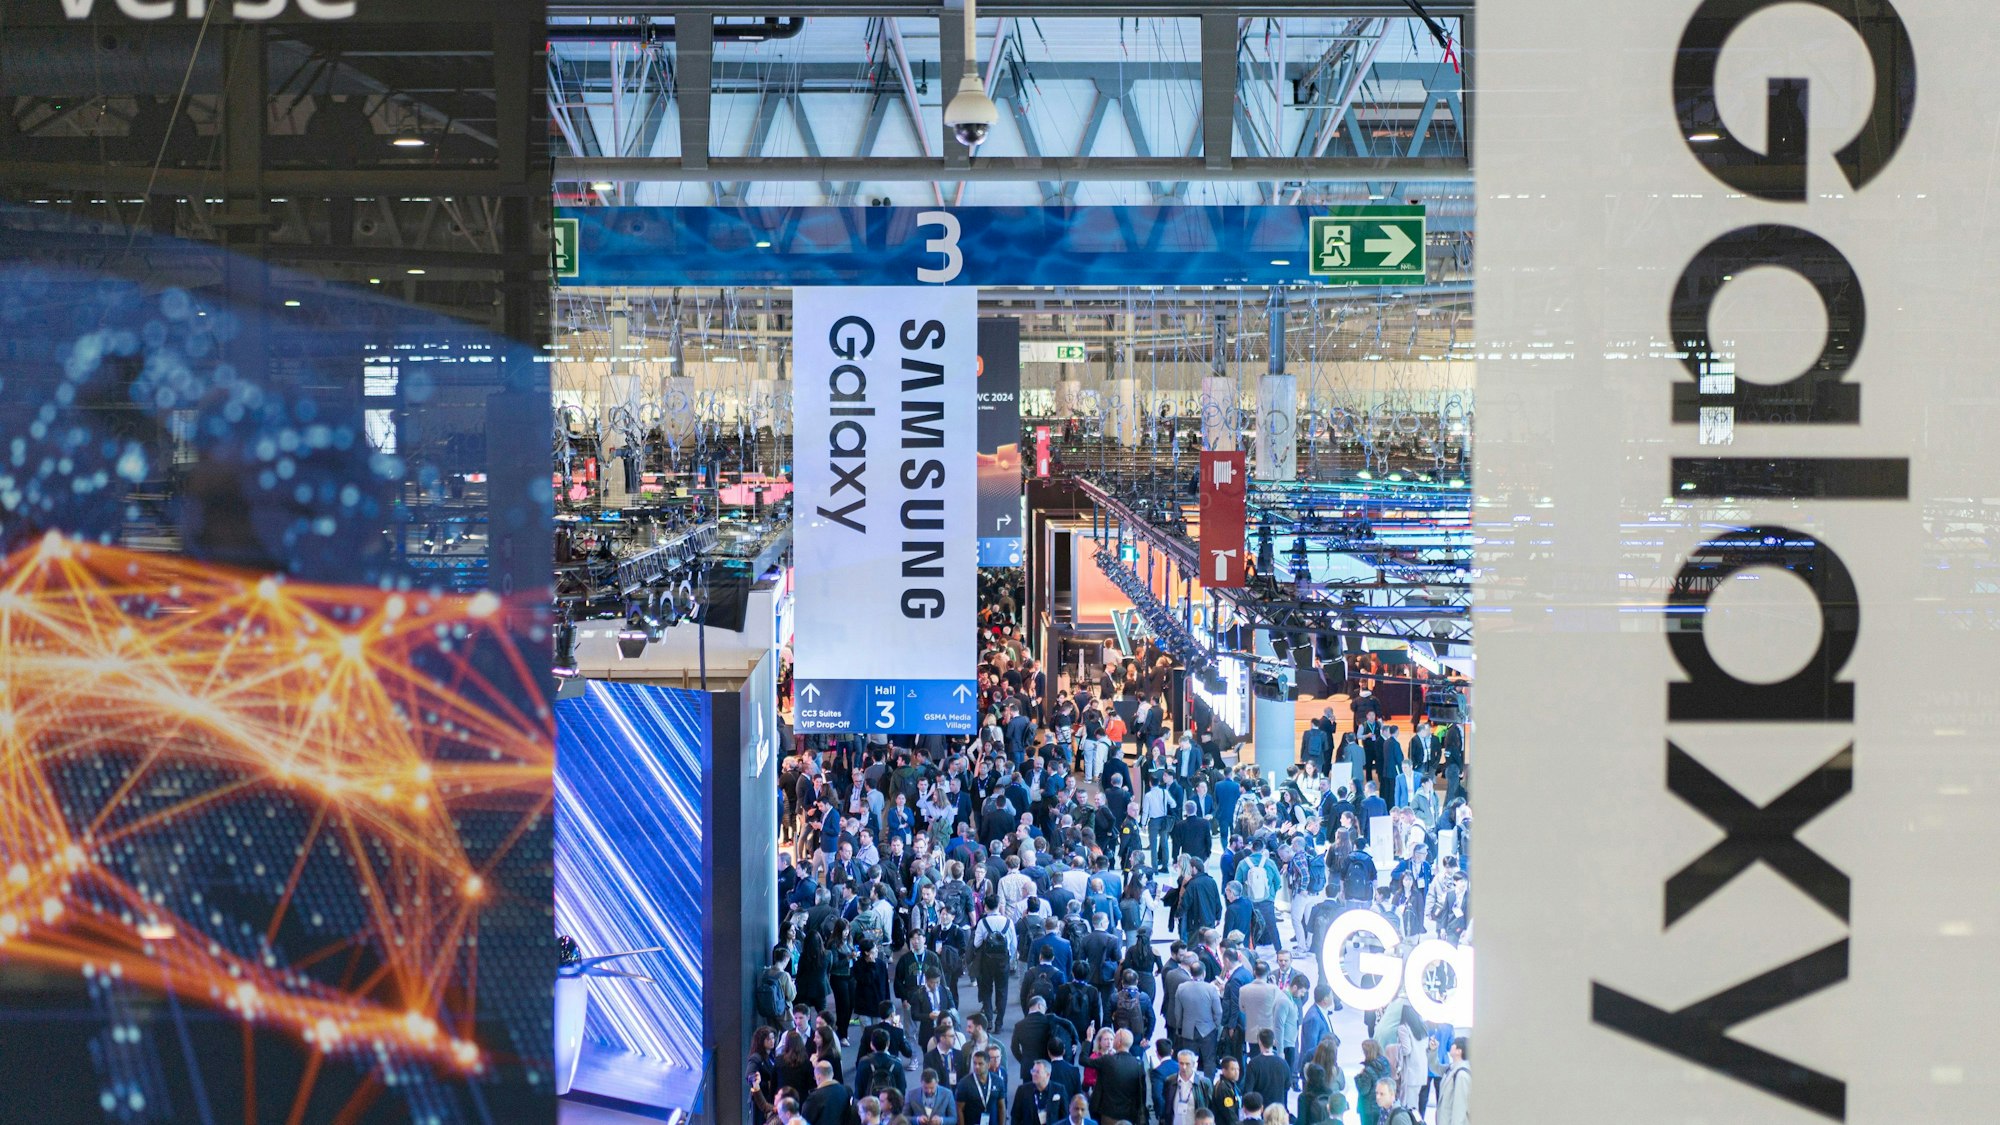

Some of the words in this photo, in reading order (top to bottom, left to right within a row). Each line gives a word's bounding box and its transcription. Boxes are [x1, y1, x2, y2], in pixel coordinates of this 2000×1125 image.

[916, 211, 963, 283] 3
[991, 393, 1014, 402] 2024
[816, 315, 876, 535] Galaxy
[899, 319, 946, 620] SAMSUNG
[1590, 0, 1917, 1124] Galaxy
[875, 686, 896, 695] Hall
[801, 710, 817, 718] CC3
[818, 710, 842, 718] Suites
[874, 700, 896, 729] 3
[924, 713, 947, 721] GSMA
[948, 713, 972, 721] Media
[801, 720, 815, 729] VIP
[815, 720, 851, 730] Drop-Off
[945, 721, 972, 730] Village
